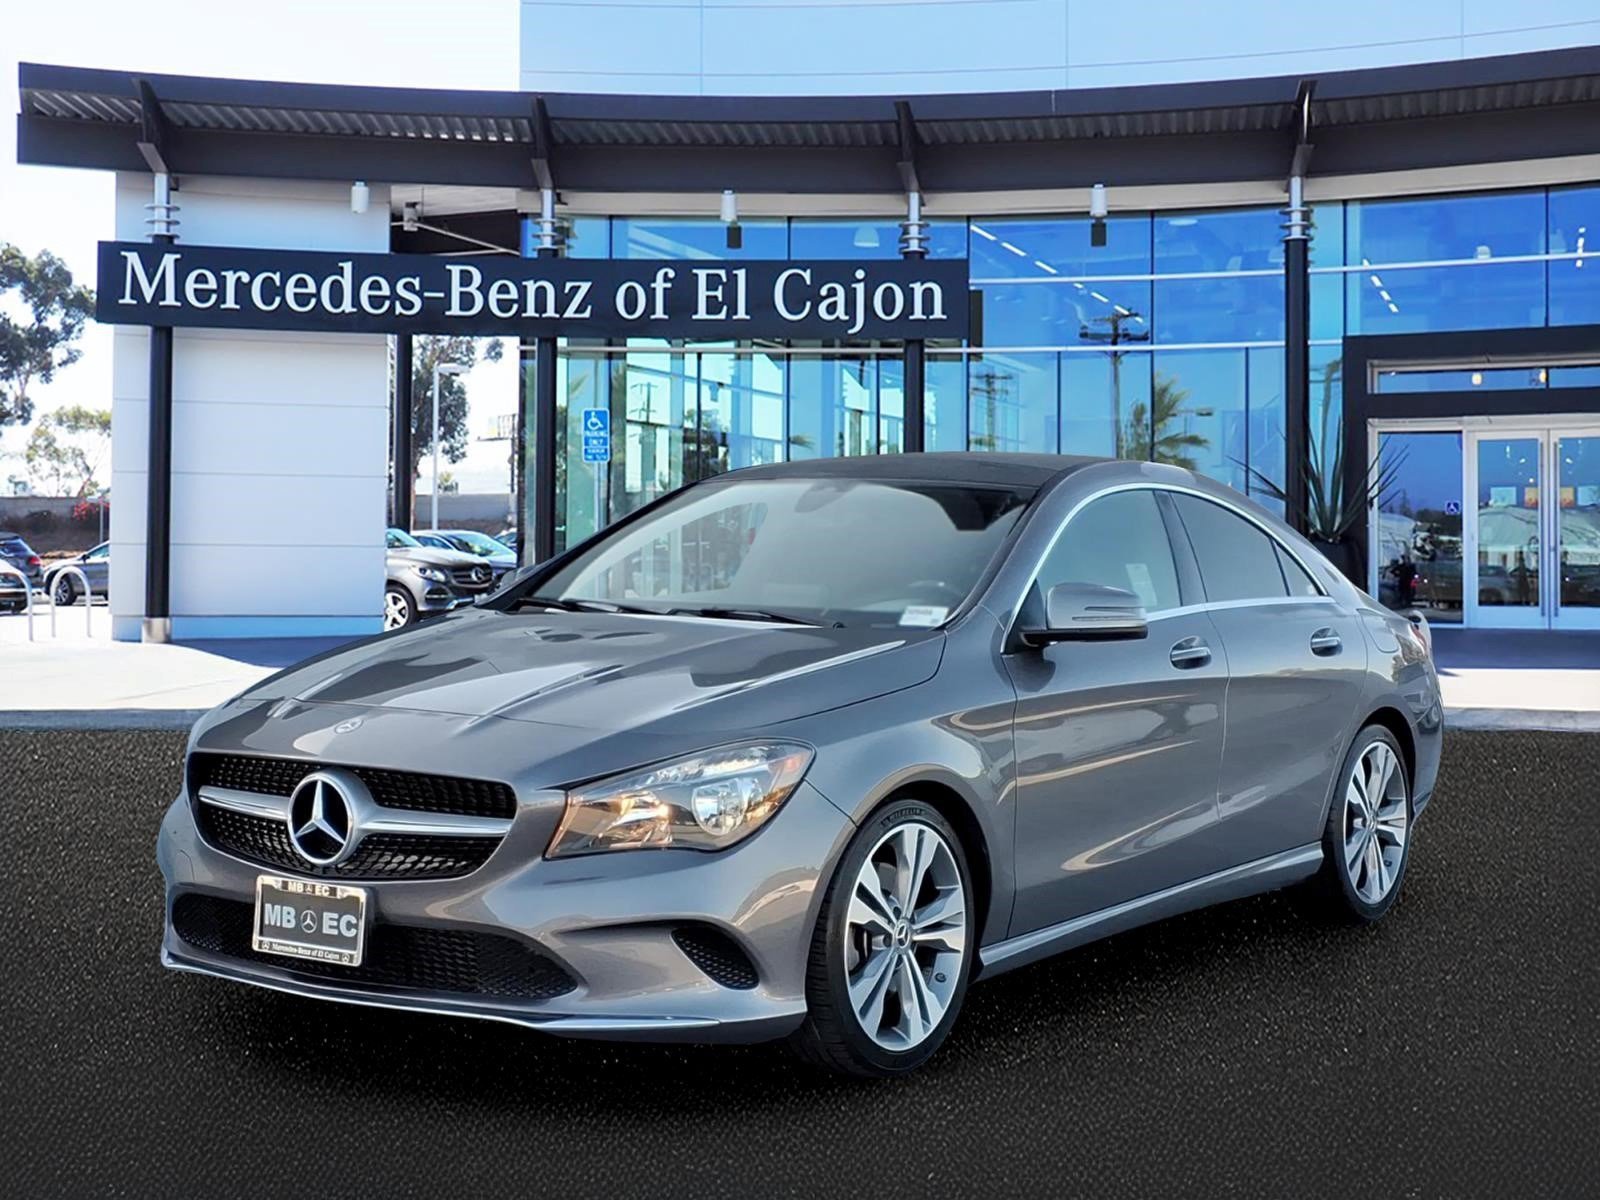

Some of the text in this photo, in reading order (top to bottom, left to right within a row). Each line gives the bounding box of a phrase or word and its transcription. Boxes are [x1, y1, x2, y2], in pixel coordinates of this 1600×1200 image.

[118, 250, 948, 335] Mercedes-Benz of El Cajon
[287, 880, 331, 896] MB EC
[264, 903, 358, 937] MB EC
